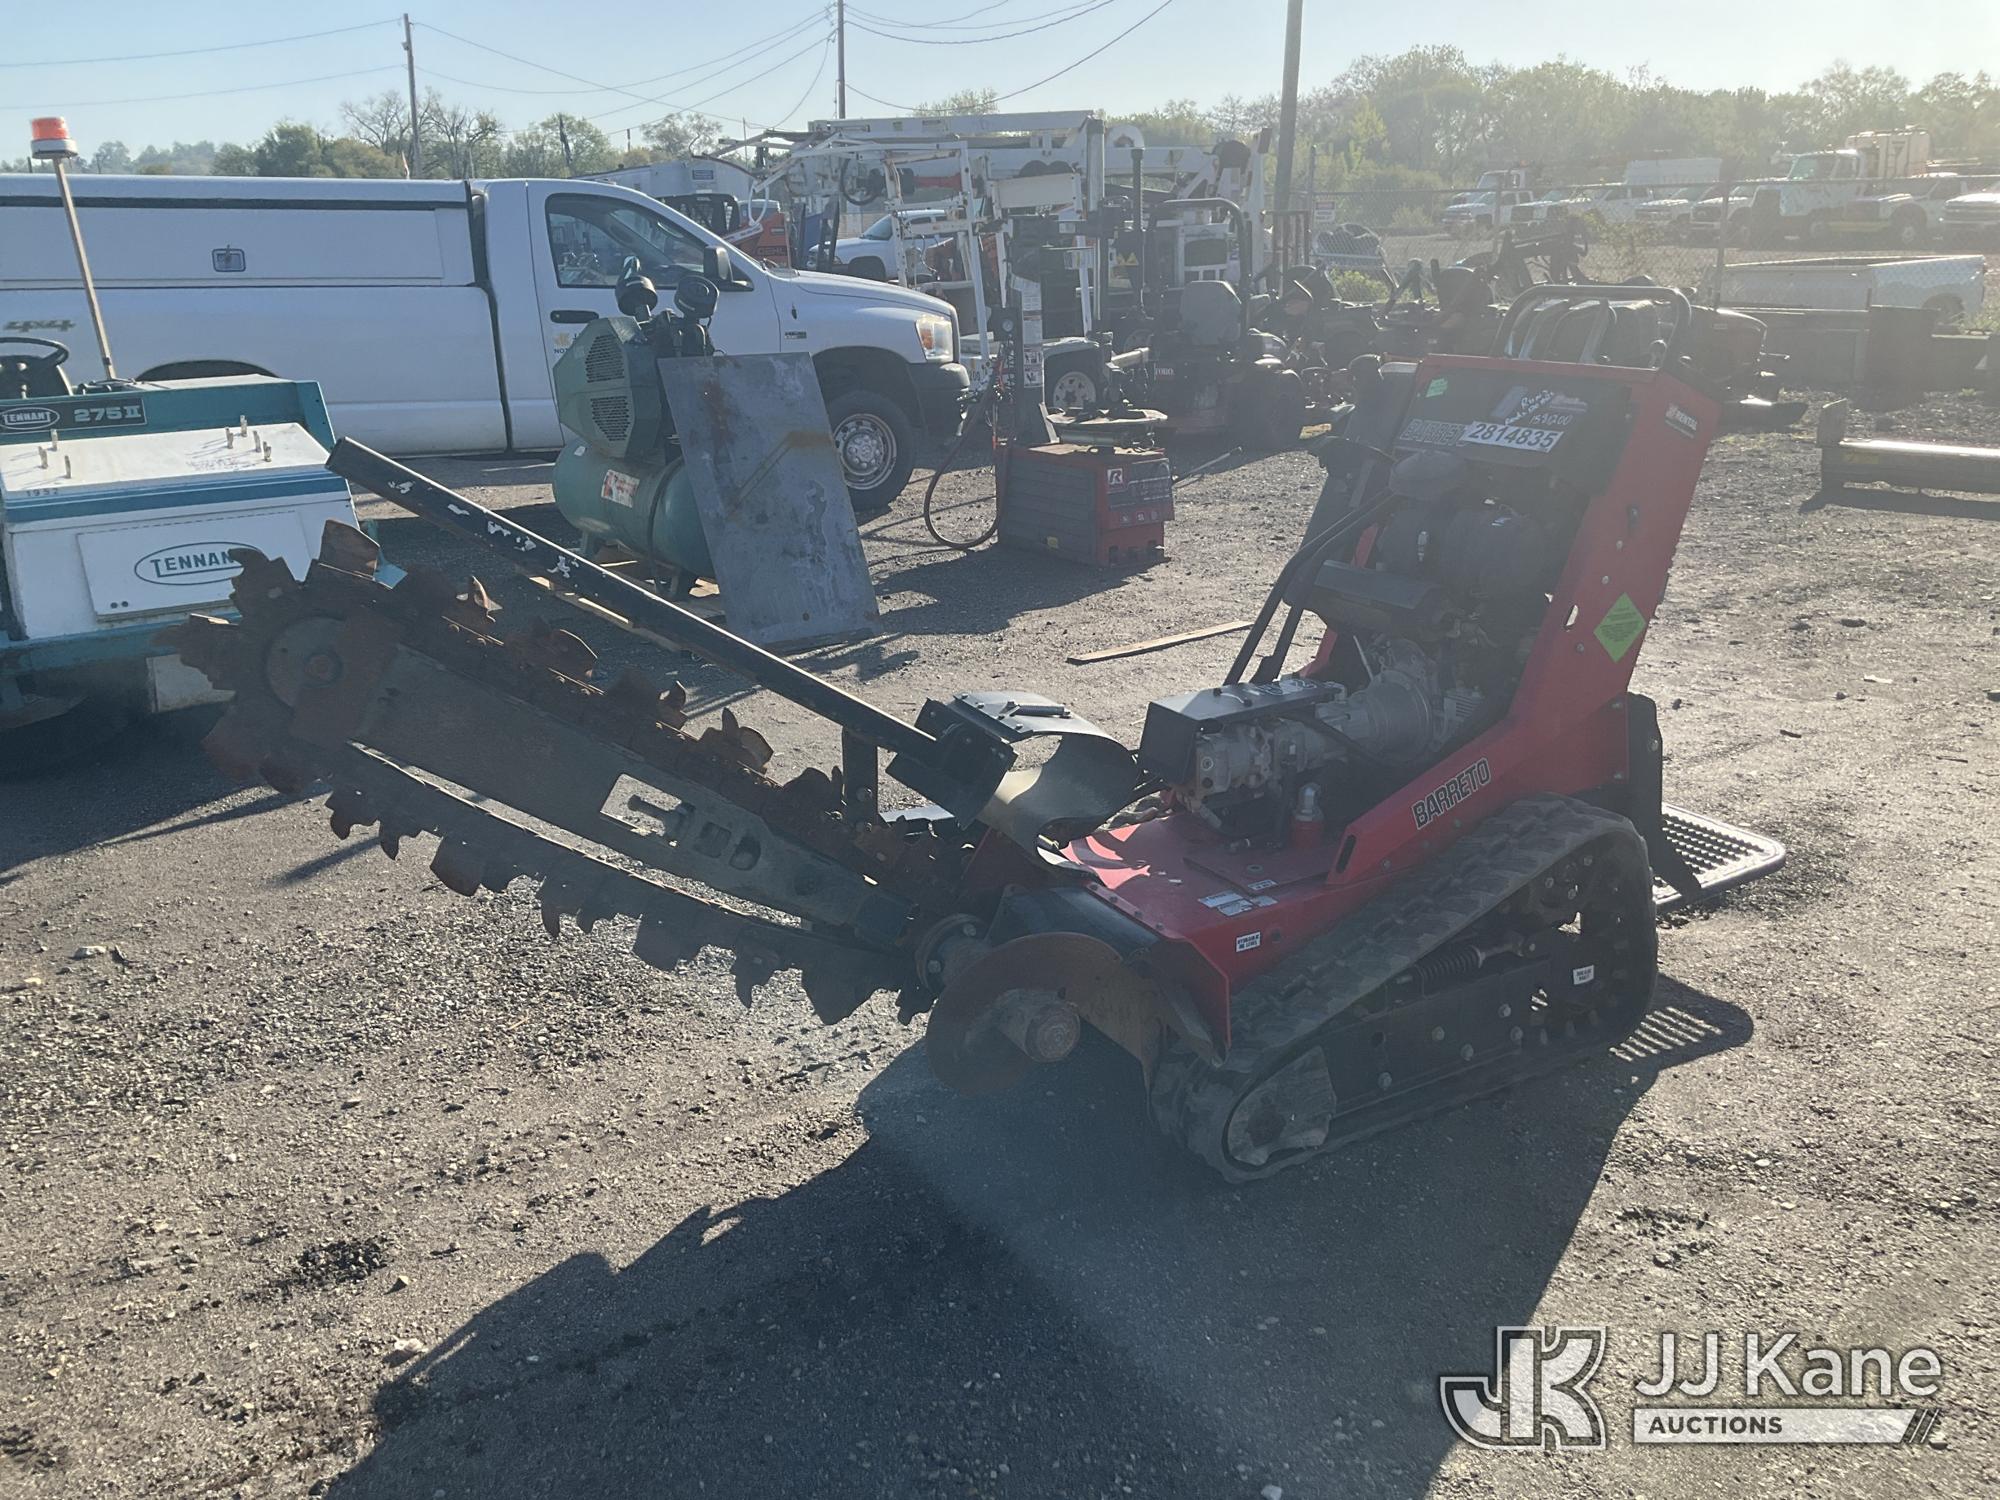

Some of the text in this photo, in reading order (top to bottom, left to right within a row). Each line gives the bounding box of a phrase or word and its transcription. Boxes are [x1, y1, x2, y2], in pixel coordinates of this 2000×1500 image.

[2, 411, 51, 425] TENNANT
[1400, 418, 1472, 447] BARRET
[1469, 423, 1559, 449] 2814835
[151, 551, 233, 577] TENNAN
[1411, 757, 1491, 830] BARRETO
